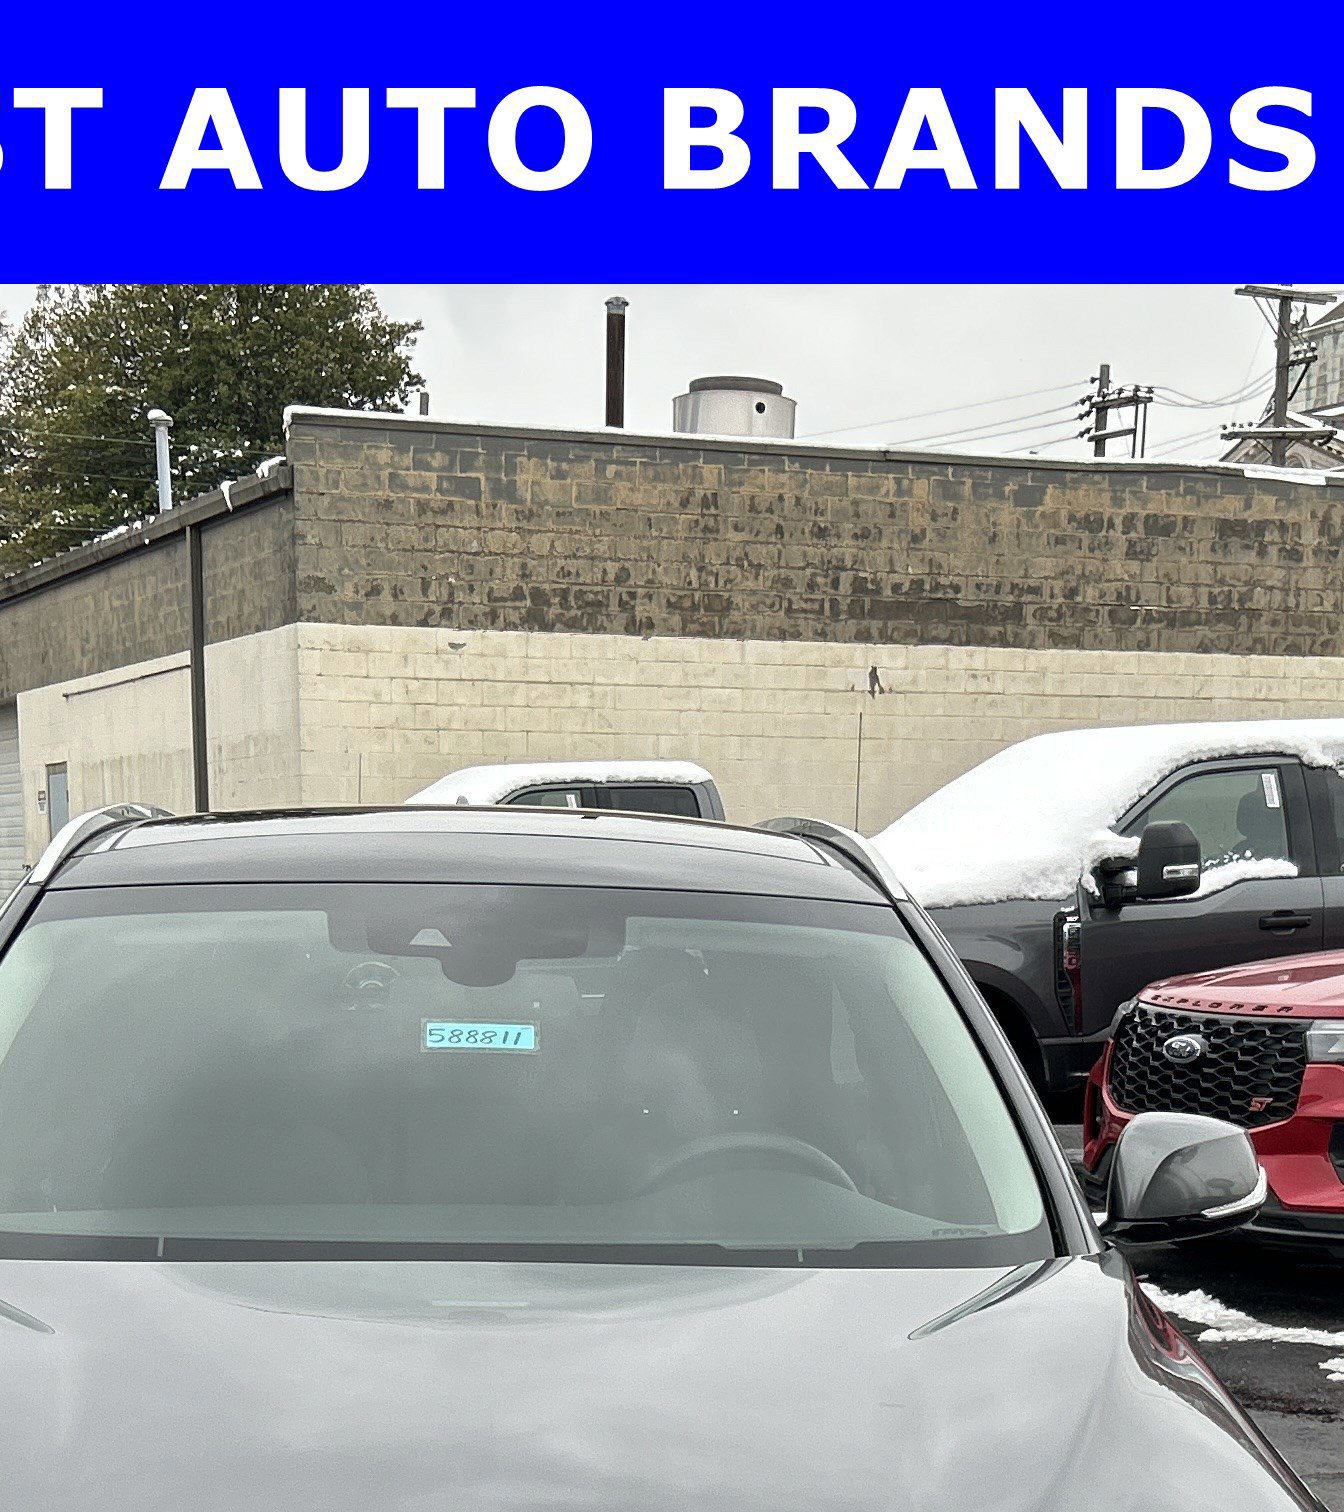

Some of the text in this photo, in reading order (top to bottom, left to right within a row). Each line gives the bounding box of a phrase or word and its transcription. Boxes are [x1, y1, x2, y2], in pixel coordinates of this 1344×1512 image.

[1151, 994, 1294, 1013] EXPLORER
[428, 1027, 523, 1046] 588811
[1249, 1097, 1274, 1111] ST
